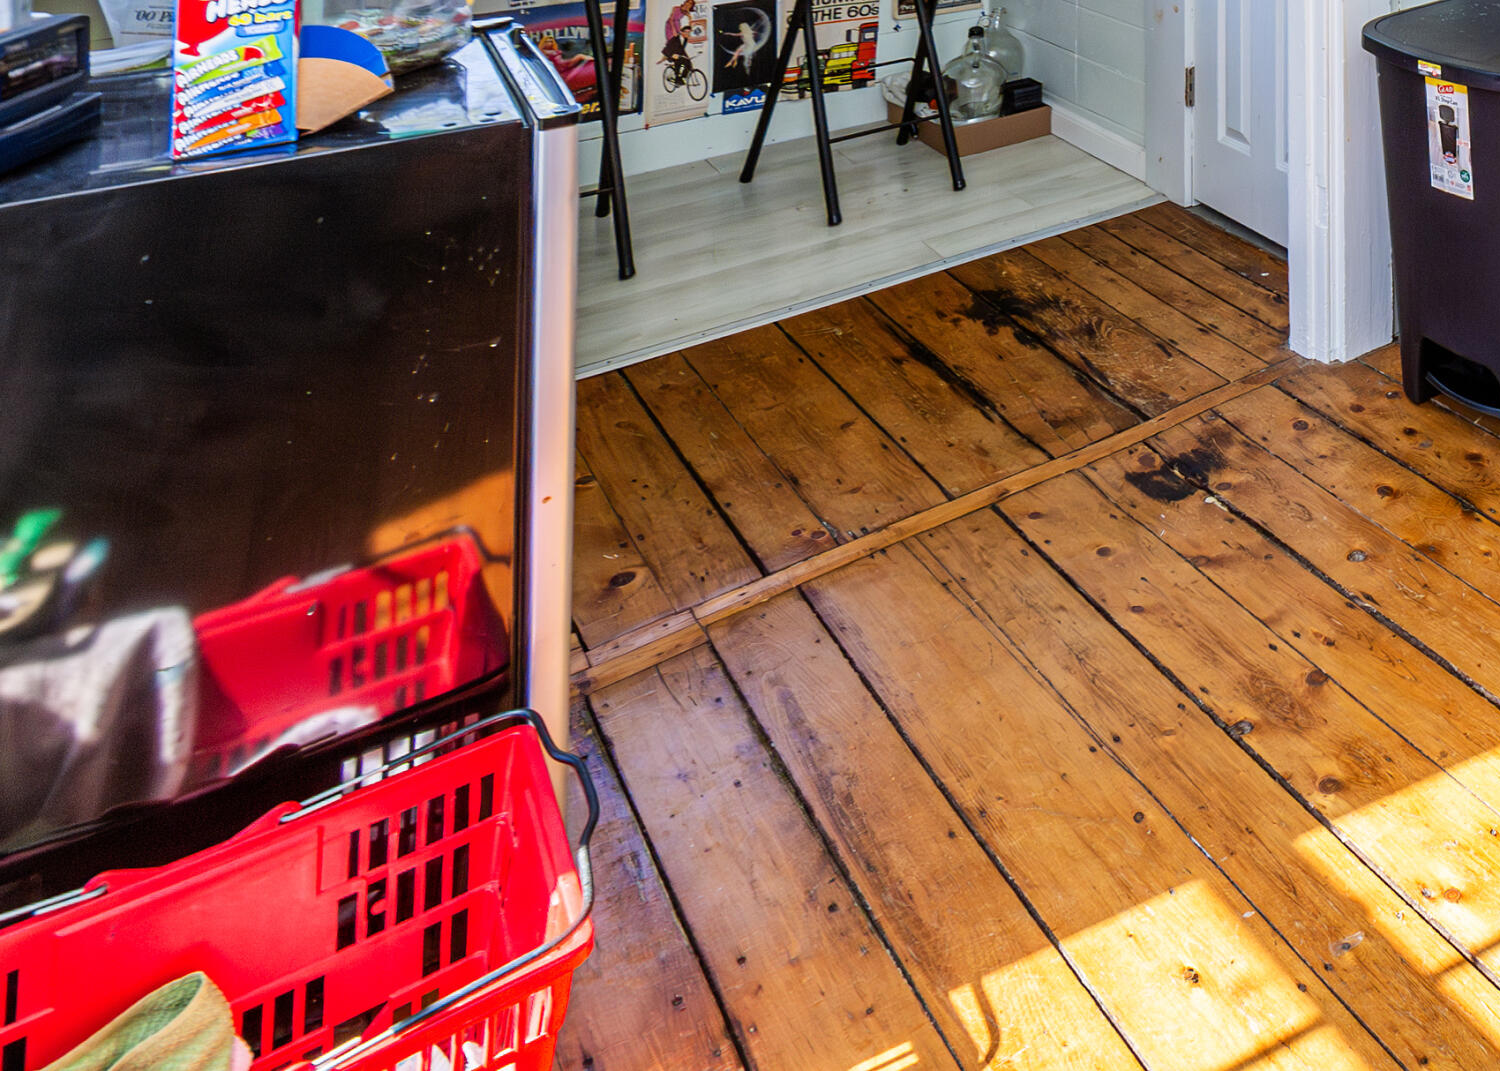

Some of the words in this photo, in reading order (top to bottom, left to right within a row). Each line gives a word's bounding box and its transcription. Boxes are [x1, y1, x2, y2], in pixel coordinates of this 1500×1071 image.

[228, 13, 253, 26] 60
[253, 10, 294, 24] bars
[812, 8, 842, 23] THE
[725, 94, 766, 108] KAVU
